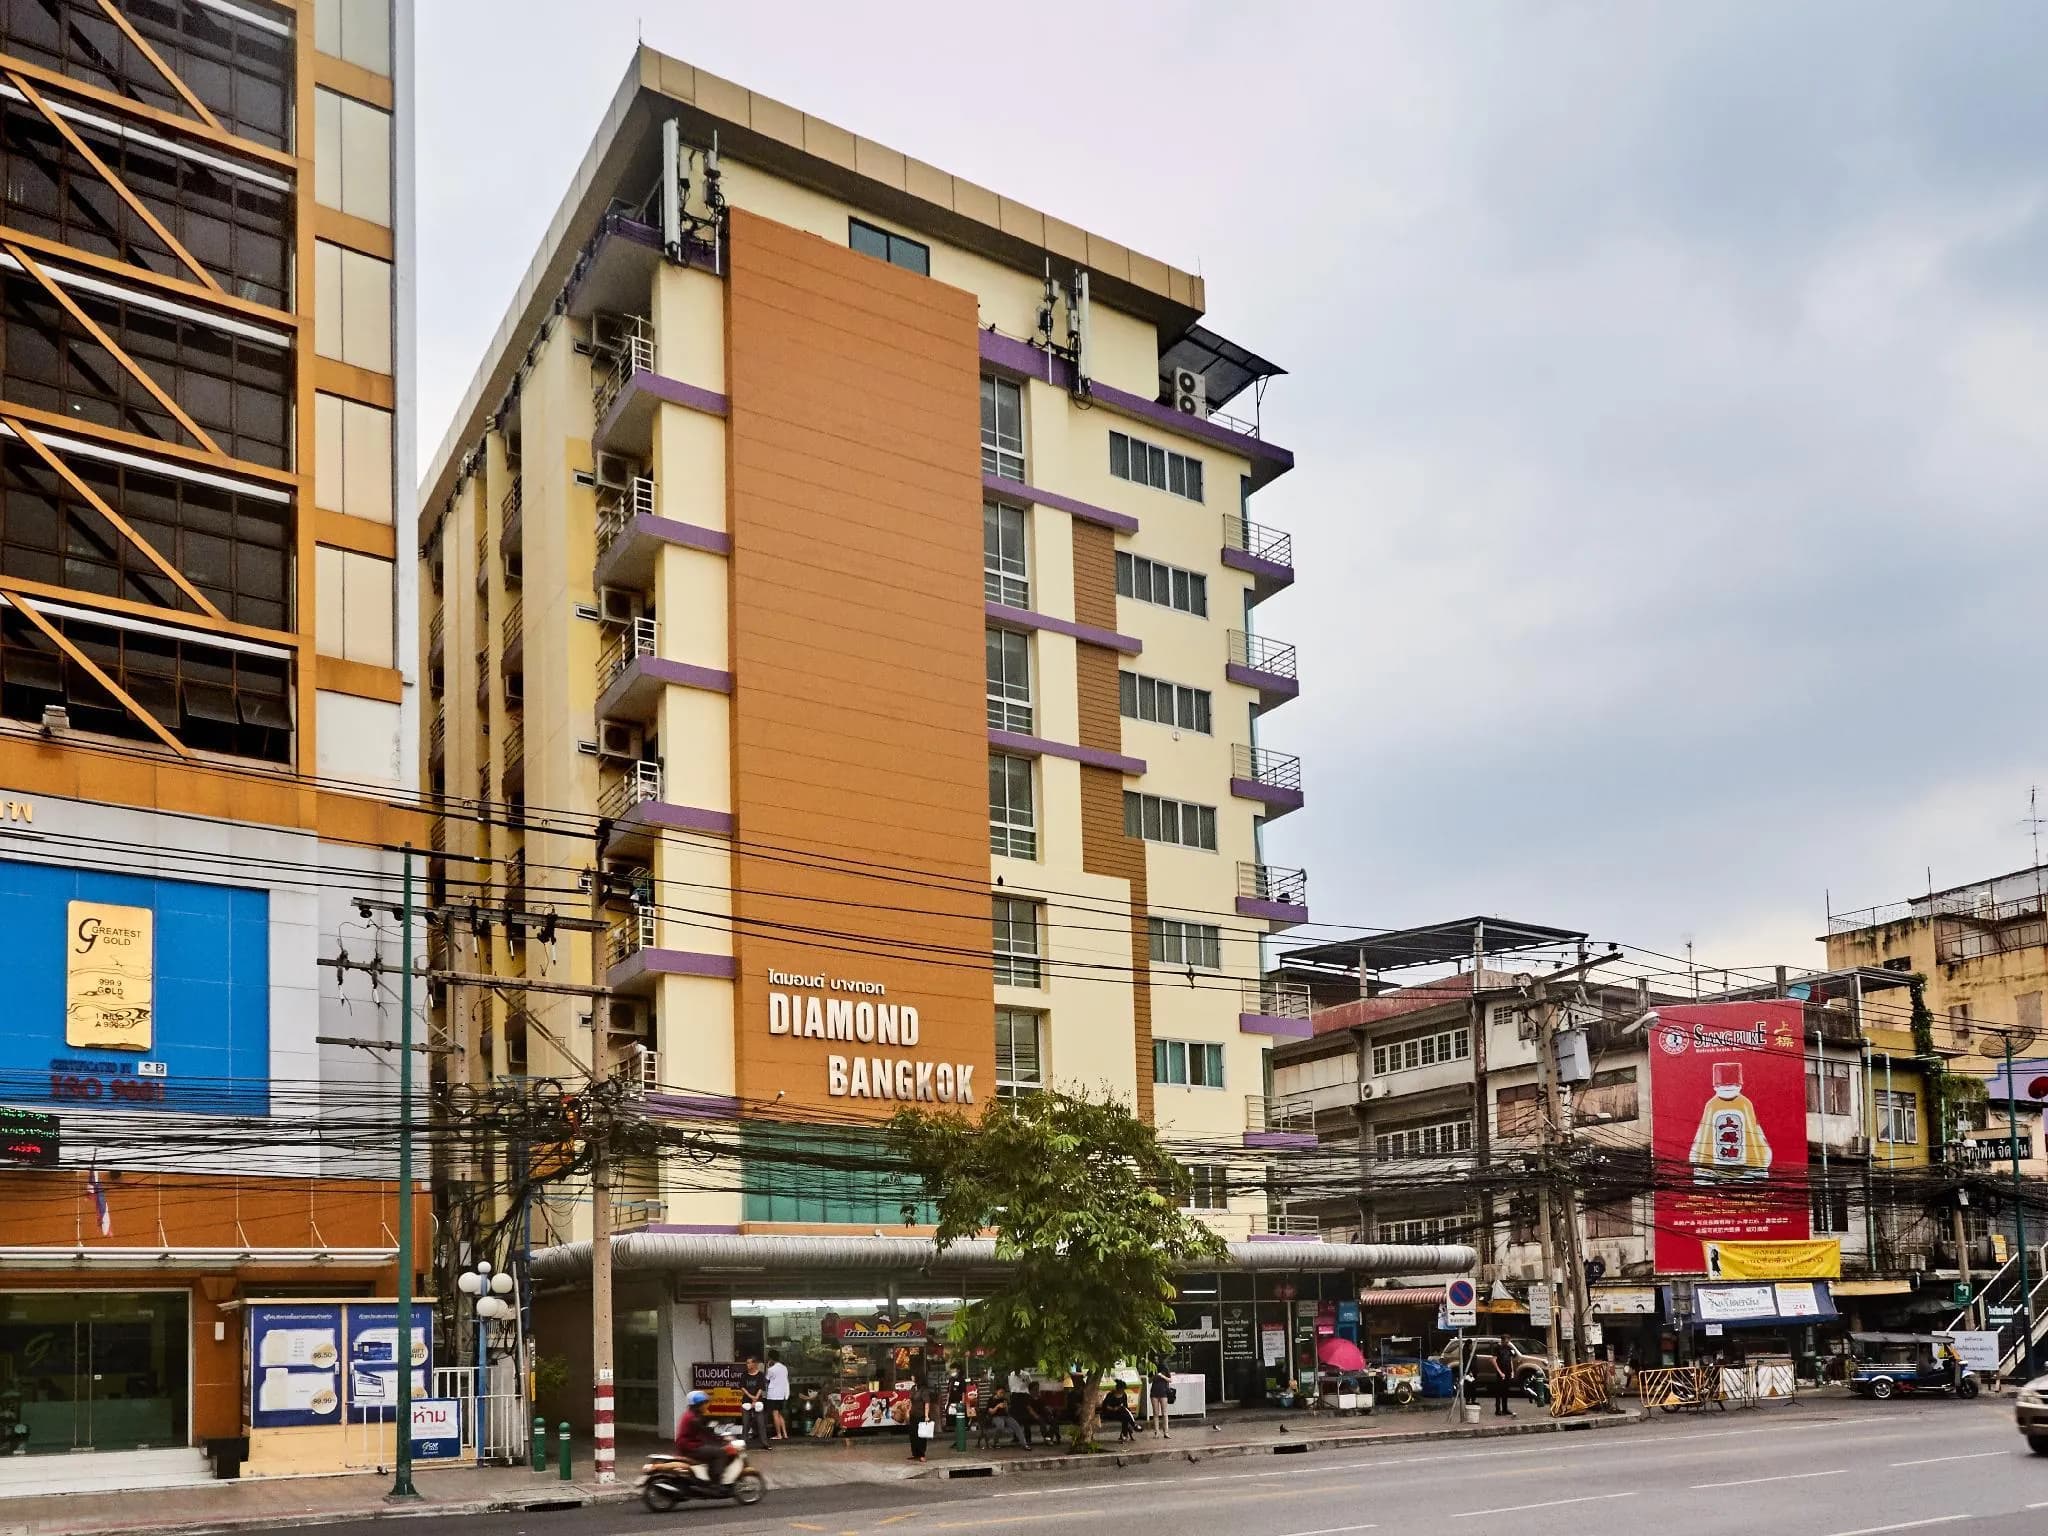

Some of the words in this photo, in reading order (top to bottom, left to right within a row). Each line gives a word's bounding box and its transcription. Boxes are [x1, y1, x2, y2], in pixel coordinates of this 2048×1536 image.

[92, 926, 141, 938] GREATEST
[103, 936, 131, 946] GOLD
[768, 968, 825, 990] ไดมอนด์
[831, 976, 885, 995] บางกอก
[769, 992, 919, 1046] DIAMOND
[51, 1074, 103, 1099] ISO
[828, 1054, 974, 1104] BANGKOK
[413, 1405, 446, 1424] ห้าม
